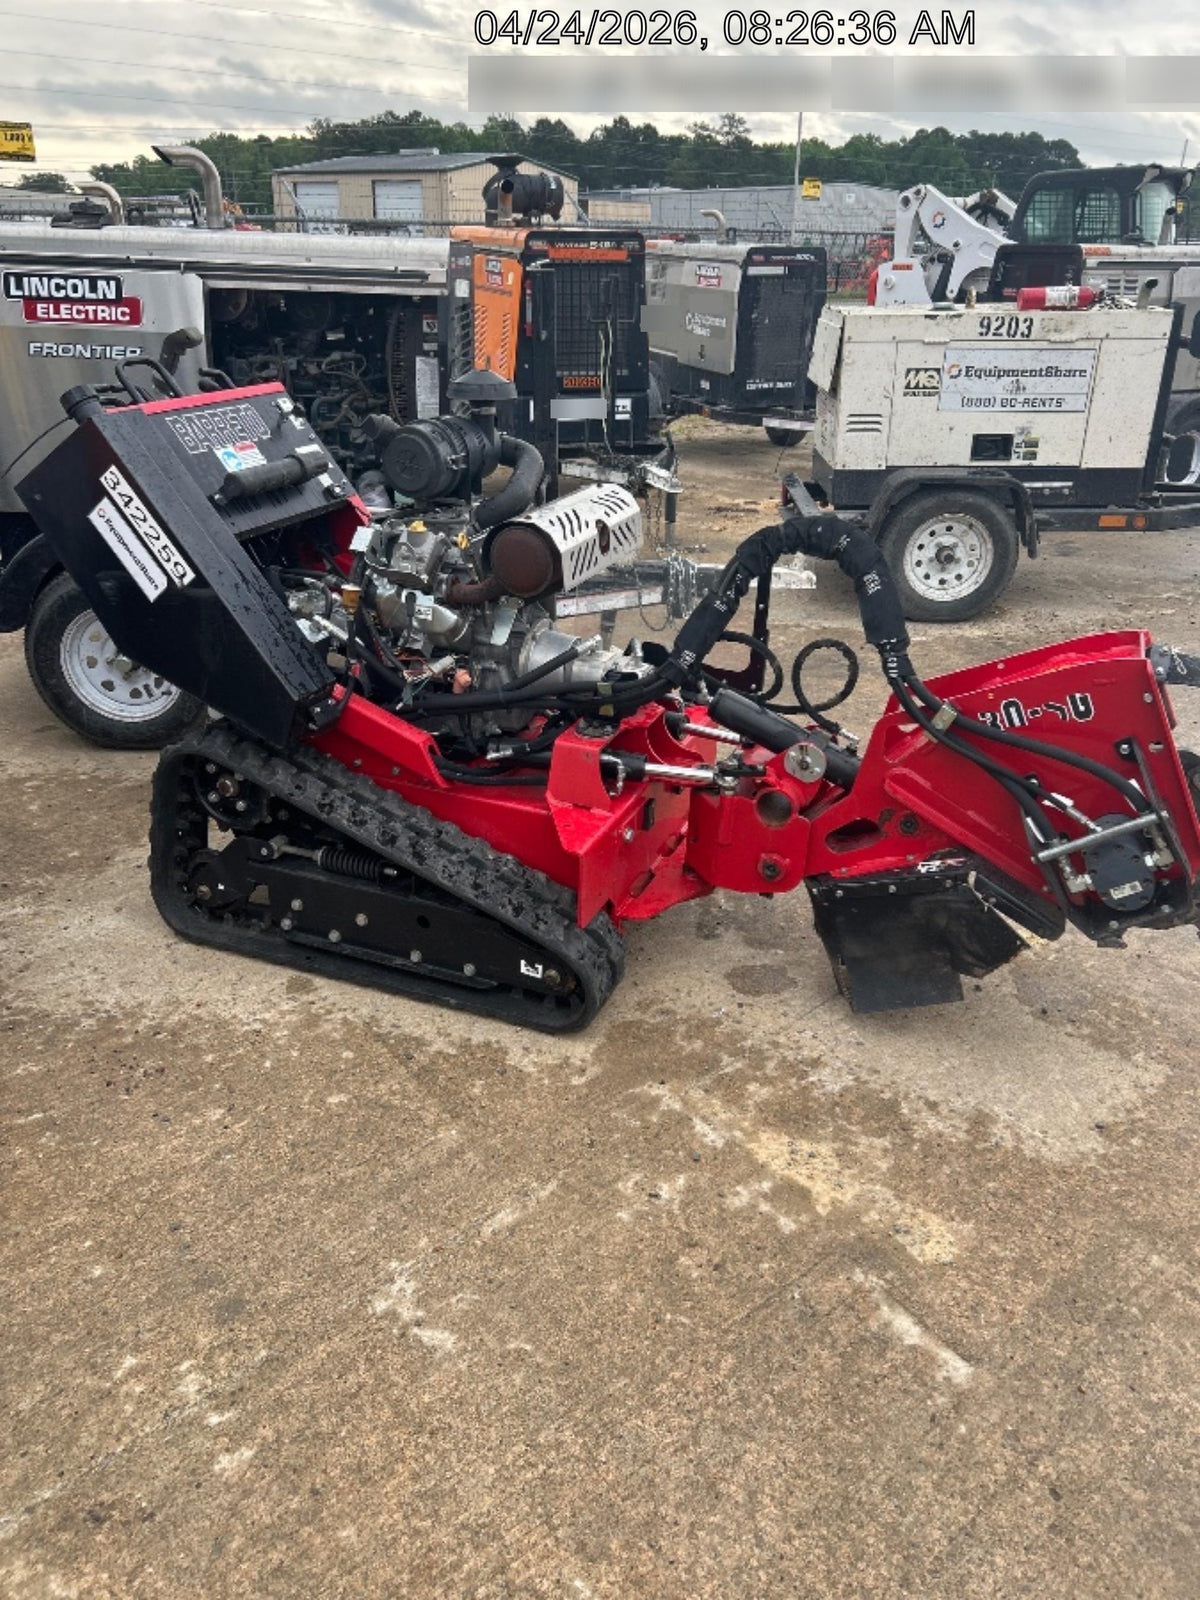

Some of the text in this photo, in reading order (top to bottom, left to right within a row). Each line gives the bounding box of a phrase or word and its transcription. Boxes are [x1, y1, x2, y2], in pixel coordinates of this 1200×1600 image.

[9, 276, 116, 299] LINCOLN
[36, 303, 131, 320] ELECTRIC
[978, 316, 1034, 338] 9203
[964, 366, 1087, 379] EquipmentShare
[104, 469, 188, 582] 342259
